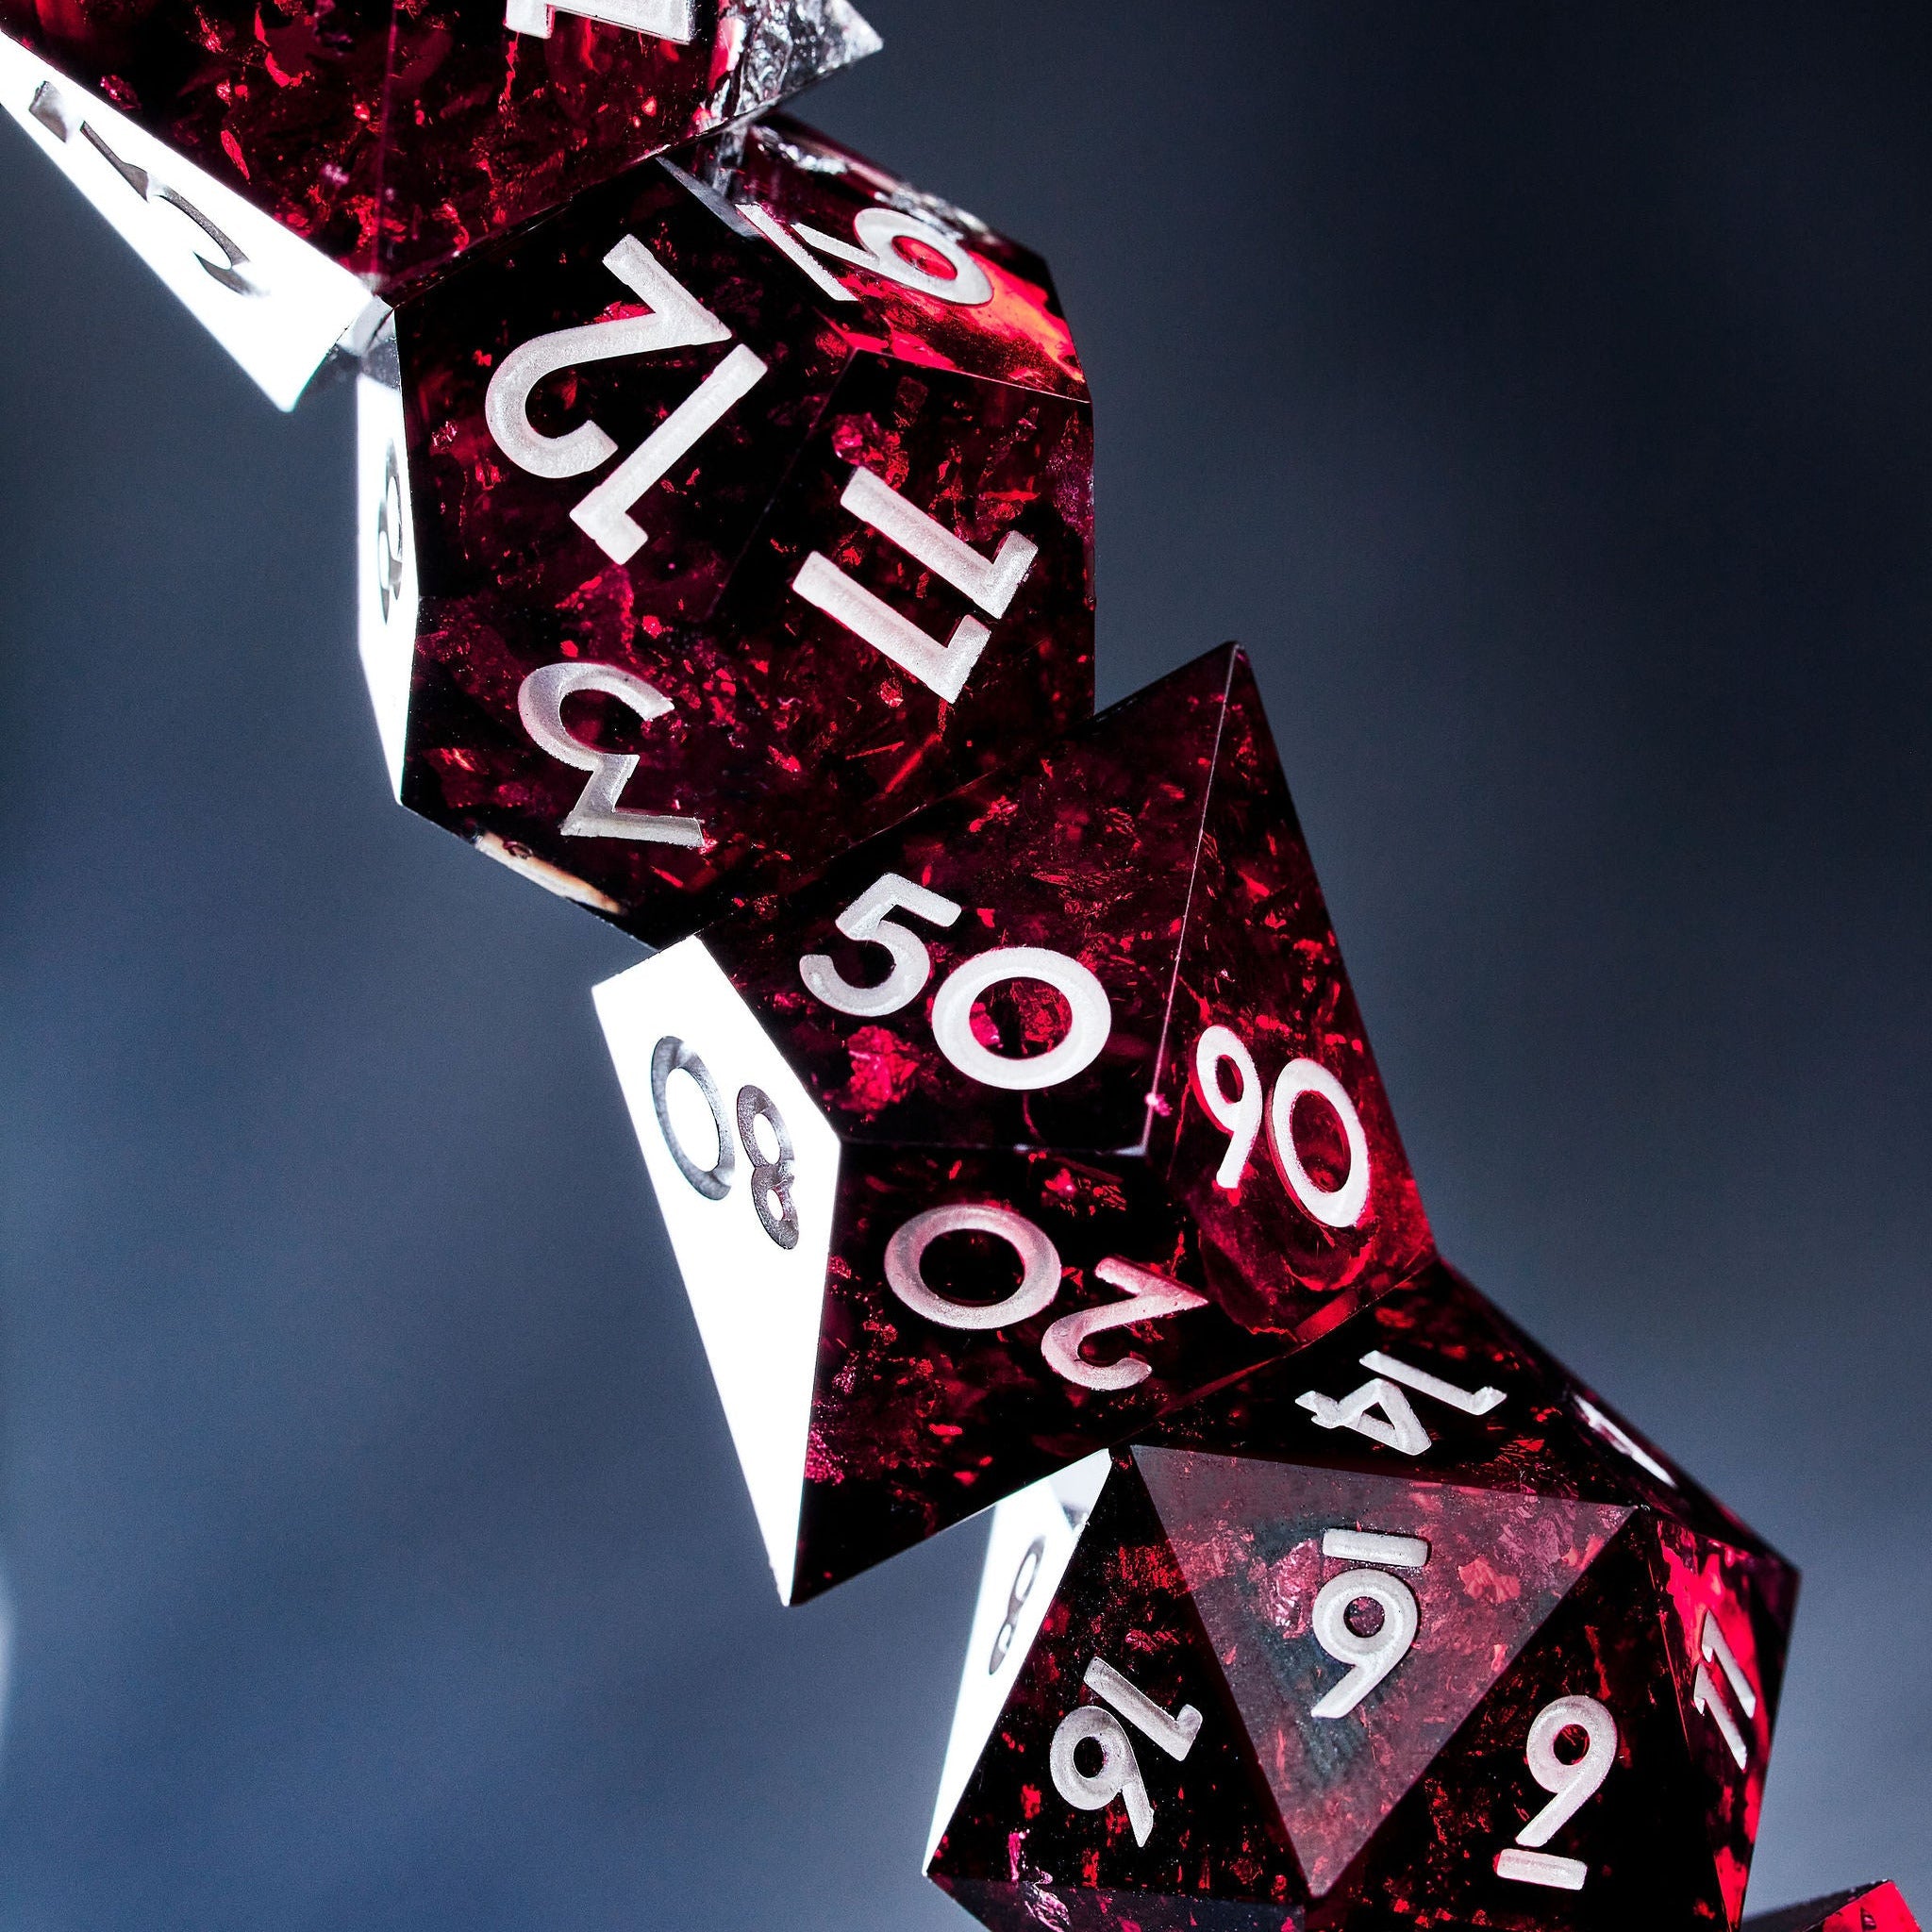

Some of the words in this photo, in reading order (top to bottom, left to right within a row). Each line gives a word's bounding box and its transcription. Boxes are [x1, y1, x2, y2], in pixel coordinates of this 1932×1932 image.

[485, 234, 768, 565] 12
[792, 466, 1038, 704] 11
[518, 662, 704, 847] 3
[800, 873, 1111, 1090] 50
[651, 1036, 799, 1250] 80
[1192, 1024, 1370, 1228] 90
[884, 1204, 1208, 1391] 20
[1295, 1350, 1507, 1457] 14
[989, 1536, 1044, 1675] 8
[1694, 1608, 1757, 1770] 11
[1050, 1657, 1203, 1847] 16
